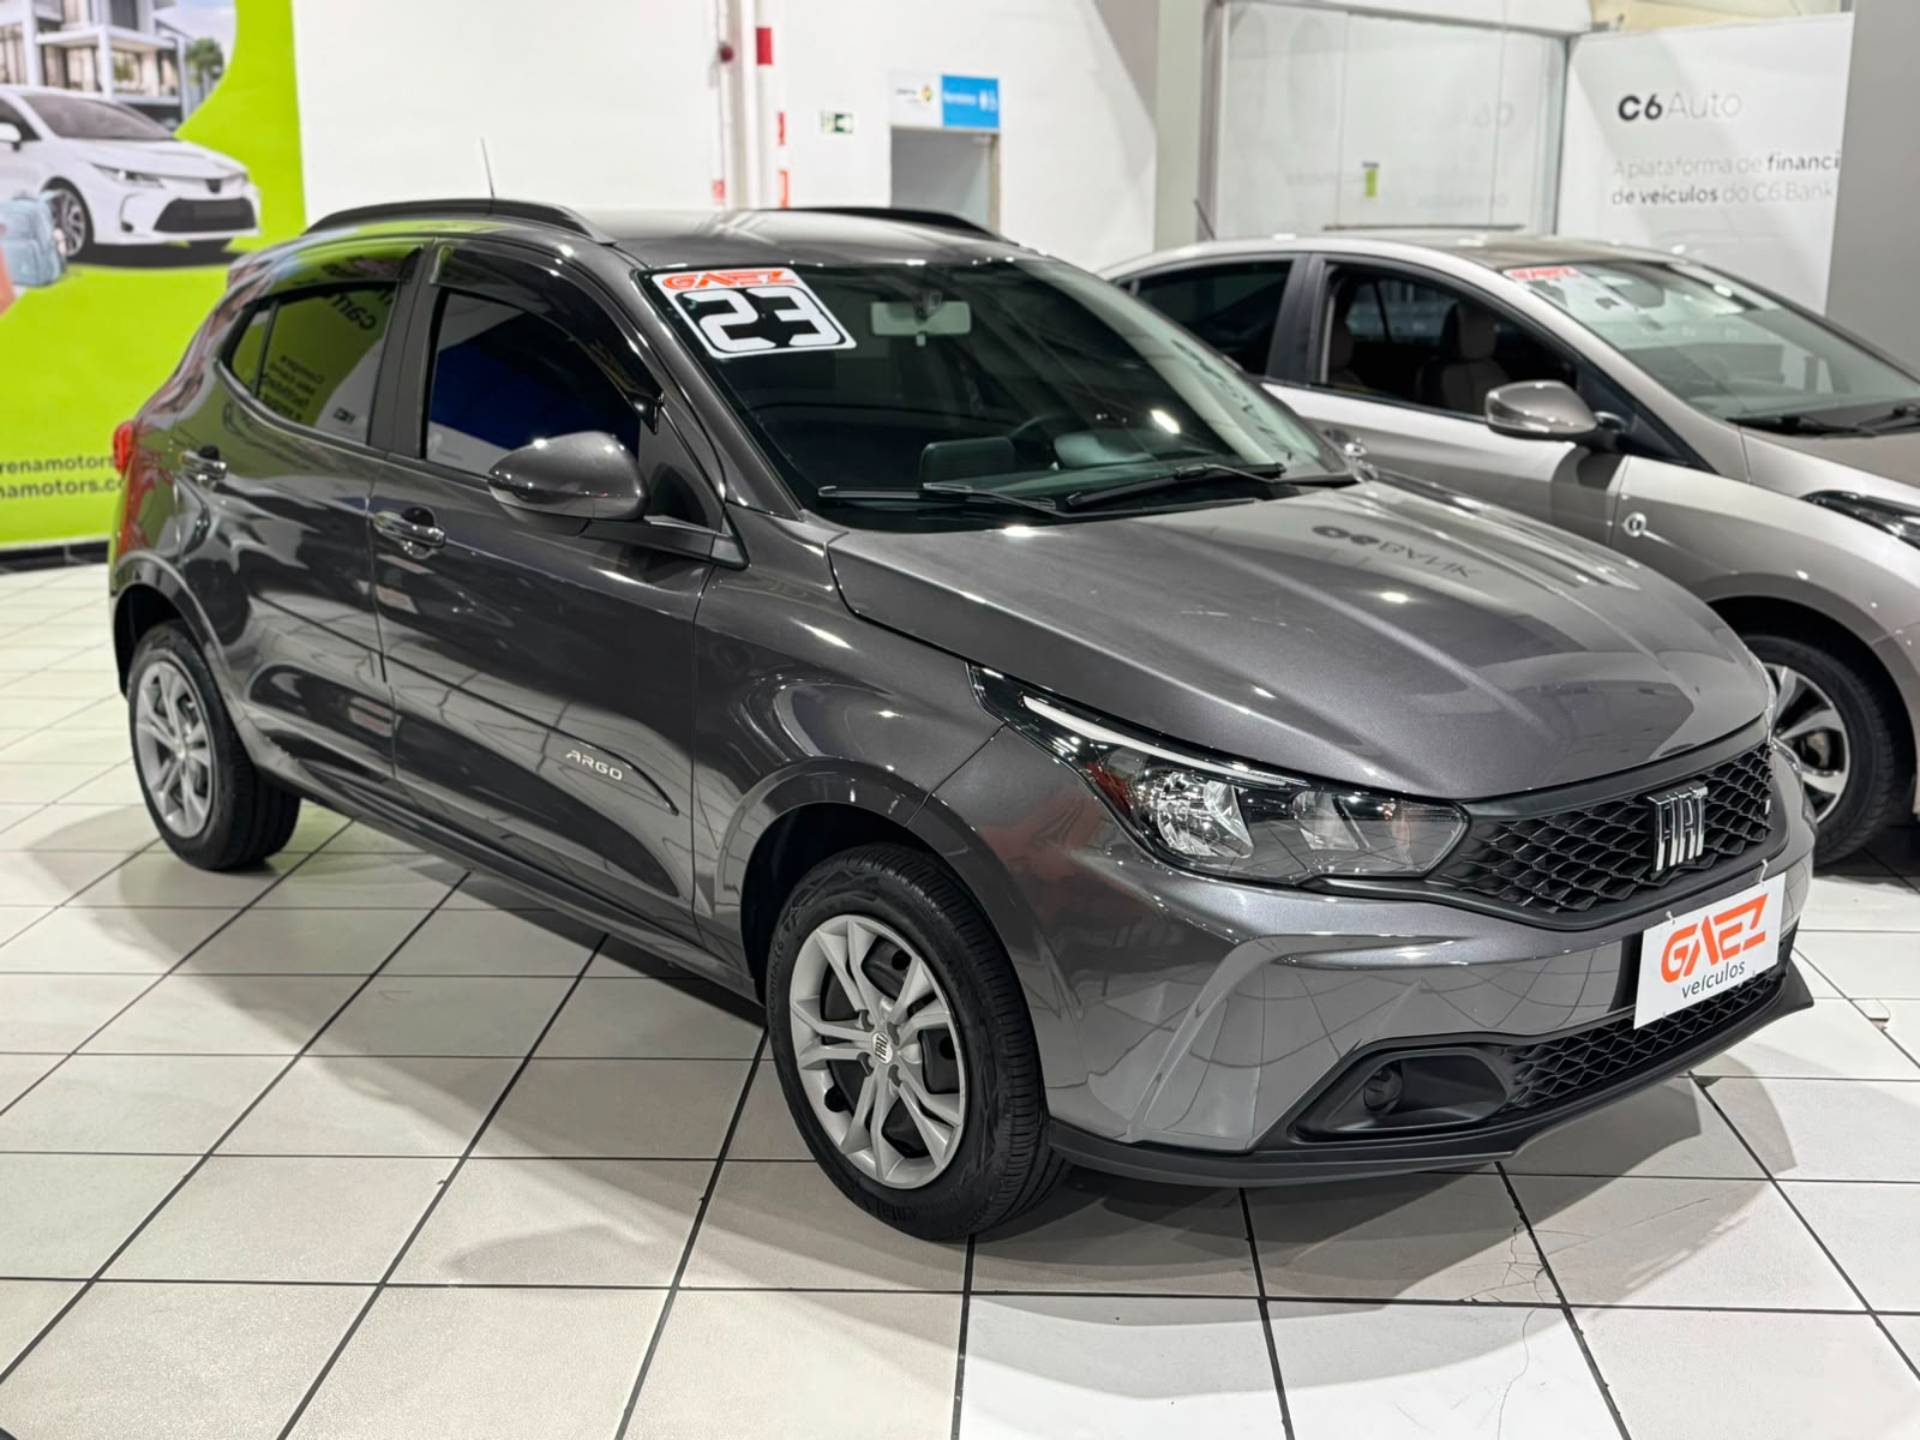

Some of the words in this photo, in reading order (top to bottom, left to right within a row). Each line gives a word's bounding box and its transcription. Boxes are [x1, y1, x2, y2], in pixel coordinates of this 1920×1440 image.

[1612, 187, 1636, 206] de
[1722, 182, 1748, 203] do
[1752, 181, 1783, 203] C6
[1785, 181, 1834, 201] Bank
[681, 285, 842, 352] 23
[565, 749, 623, 780] ARGO
[1646, 787, 1709, 872] FIAT
[1660, 893, 1769, 983] GAEZ
